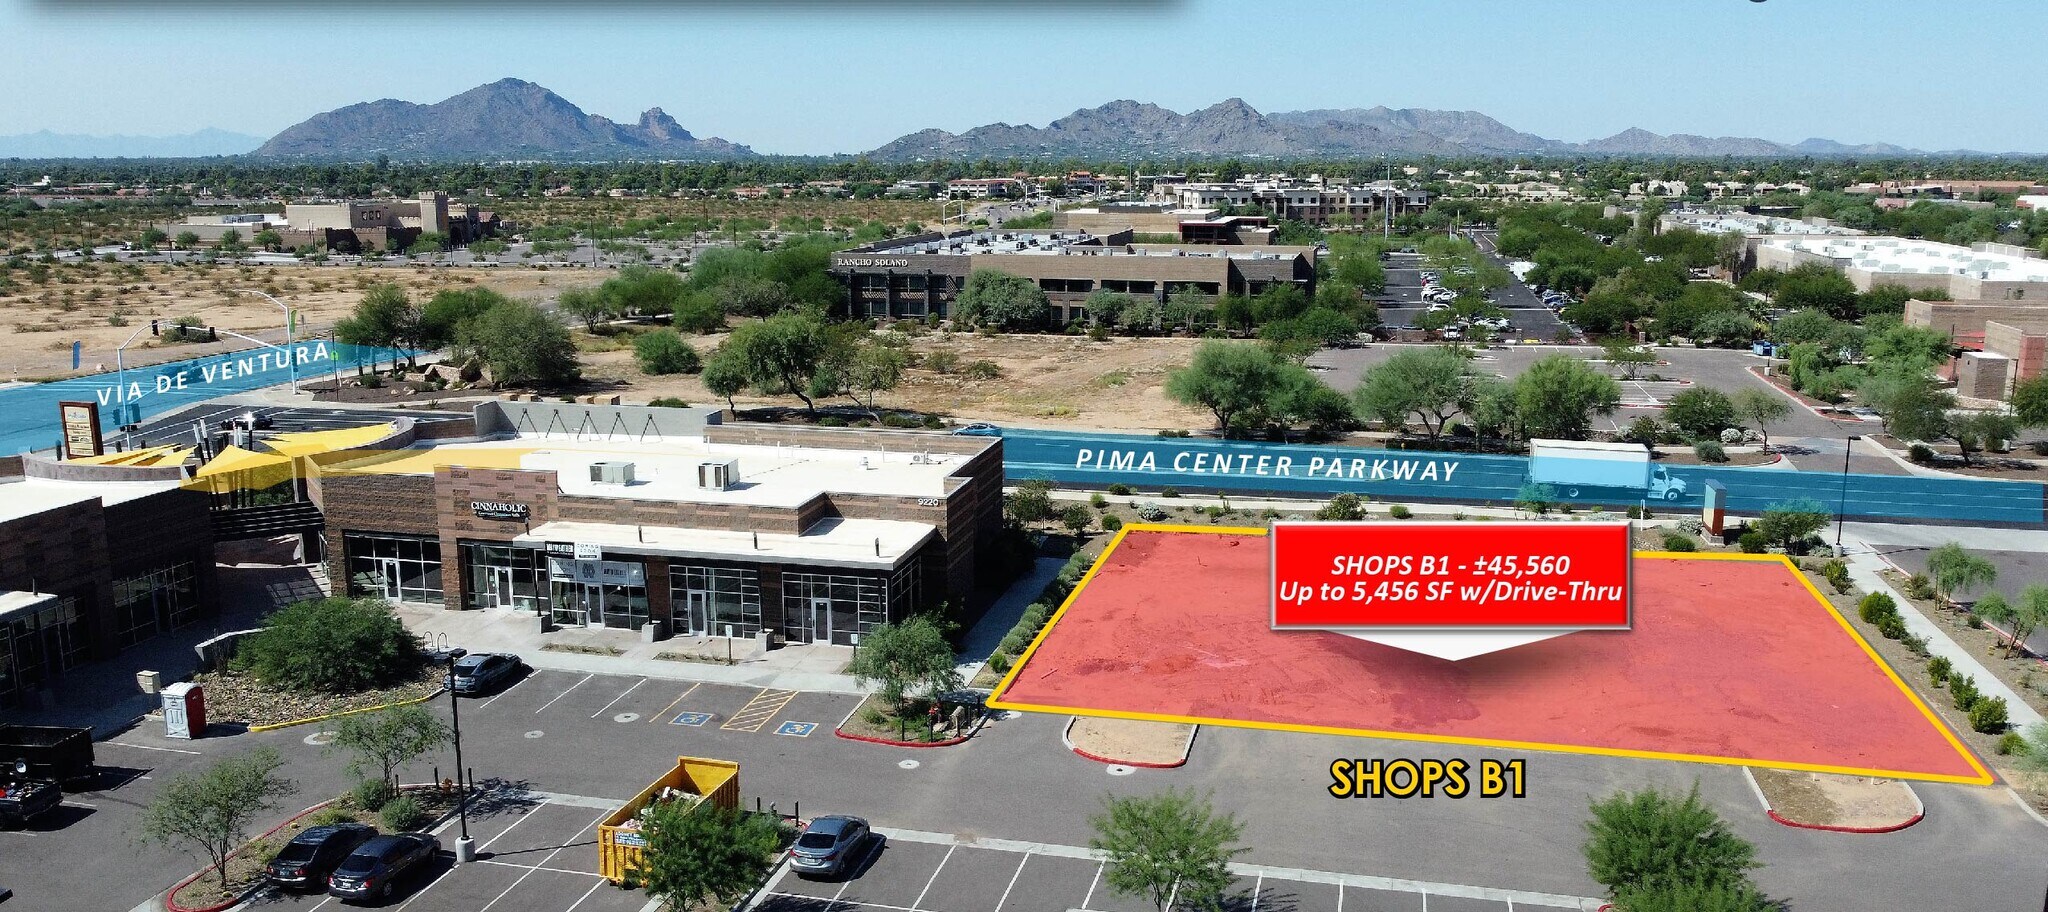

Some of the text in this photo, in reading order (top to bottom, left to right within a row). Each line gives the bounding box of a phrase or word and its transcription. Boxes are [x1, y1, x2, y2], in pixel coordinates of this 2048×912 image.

[838, 258, 908, 267] RANCHO SOLANO
[471, 501, 527, 513] CINNAHOLIC
